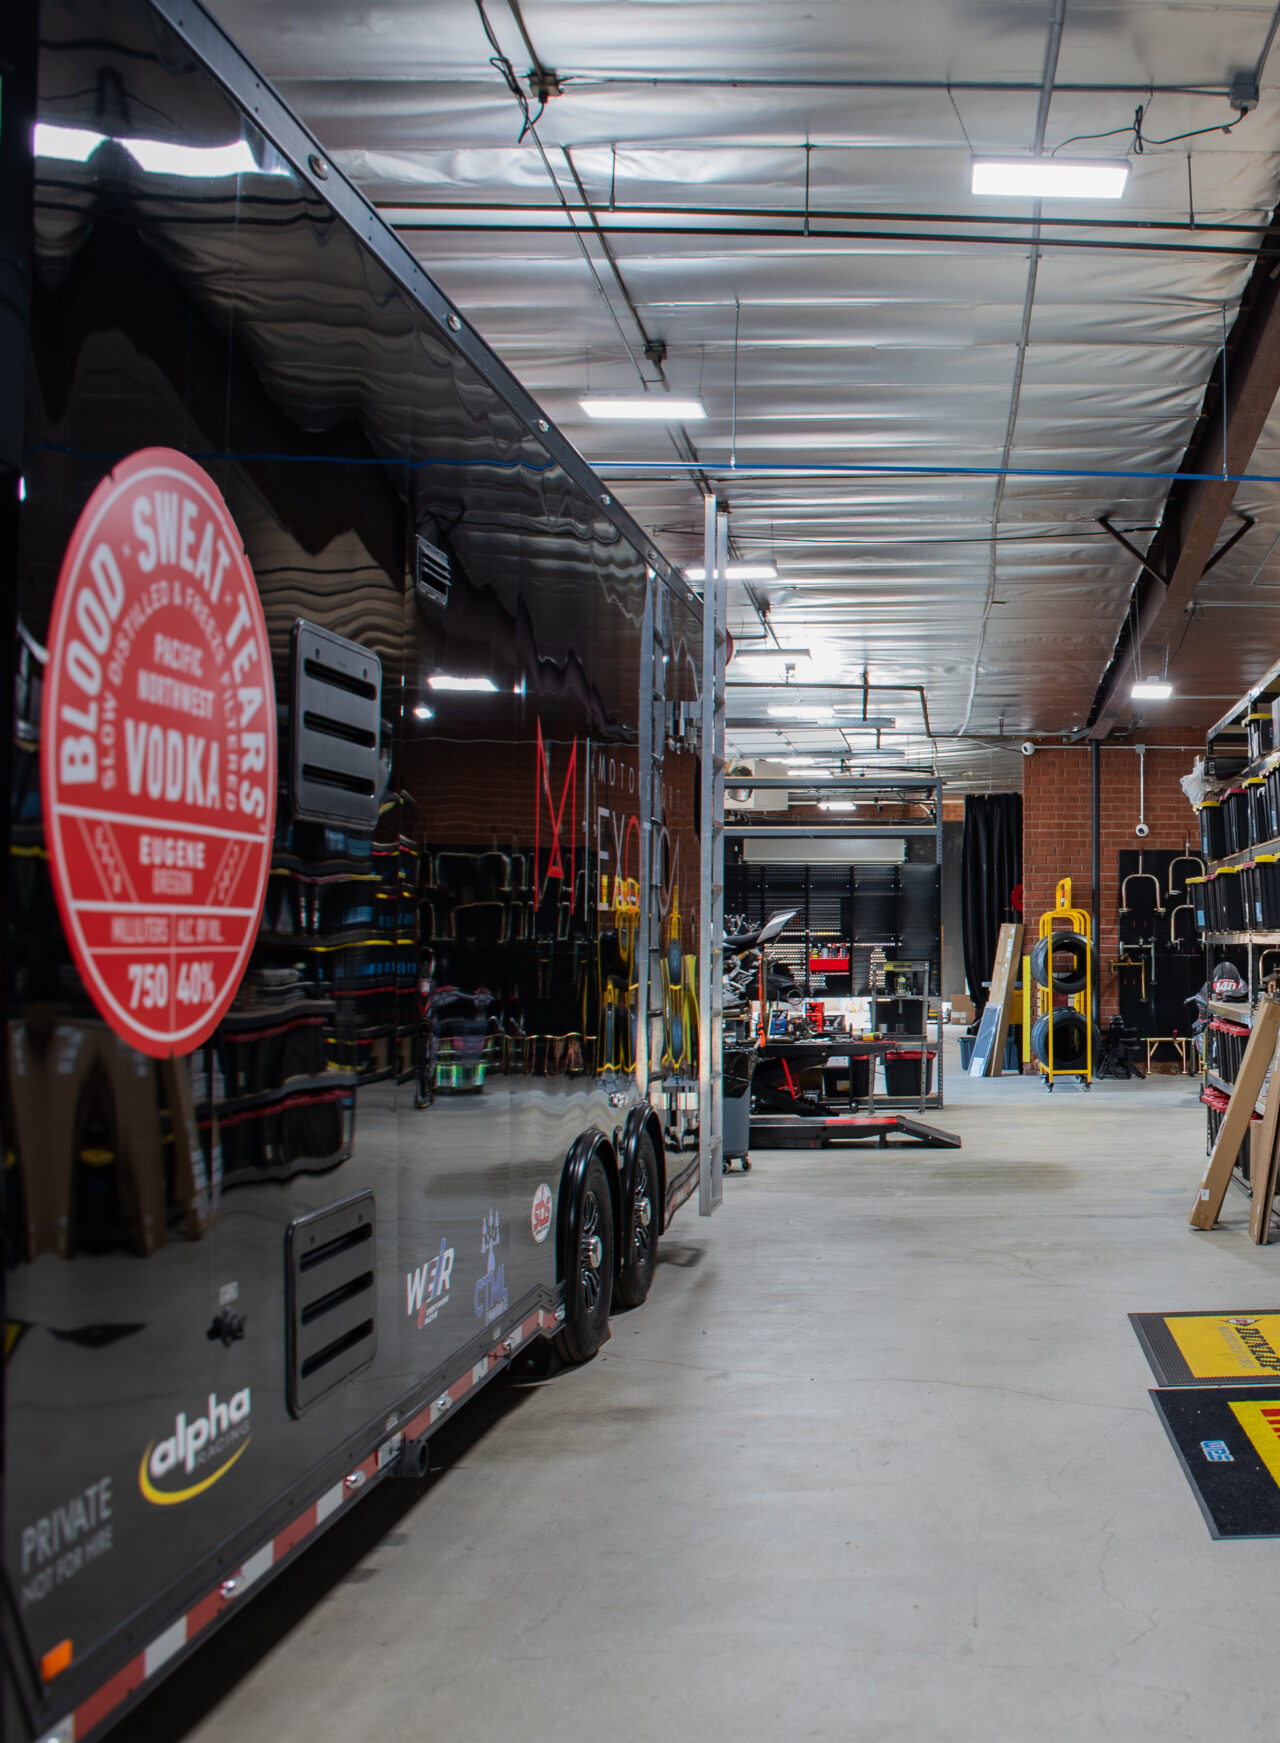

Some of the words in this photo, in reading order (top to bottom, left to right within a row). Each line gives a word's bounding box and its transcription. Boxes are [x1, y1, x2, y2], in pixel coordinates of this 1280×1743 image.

[61, 543, 125, 784] BLOOD
[133, 491, 230, 601] SWEAT
[224, 593, 266, 819] TEARS
[153, 632, 204, 678] PACIFIC
[137, 667, 216, 721] NORTHWEST
[125, 717, 222, 810] VODKA
[139, 835, 205, 869] EUGENE
[127, 963, 169, 1010] 750
[176, 961, 216, 1006] 40%
[150, 1387, 251, 1478] alpha
[1200, 1439, 1235, 1462] WPS
[22, 1475, 112, 1574] PRIVATE
[21, 1565, 54, 1609] NOT
[56, 1546, 84, 1584] FOR
[85, 1524, 113, 1563] HIRE
